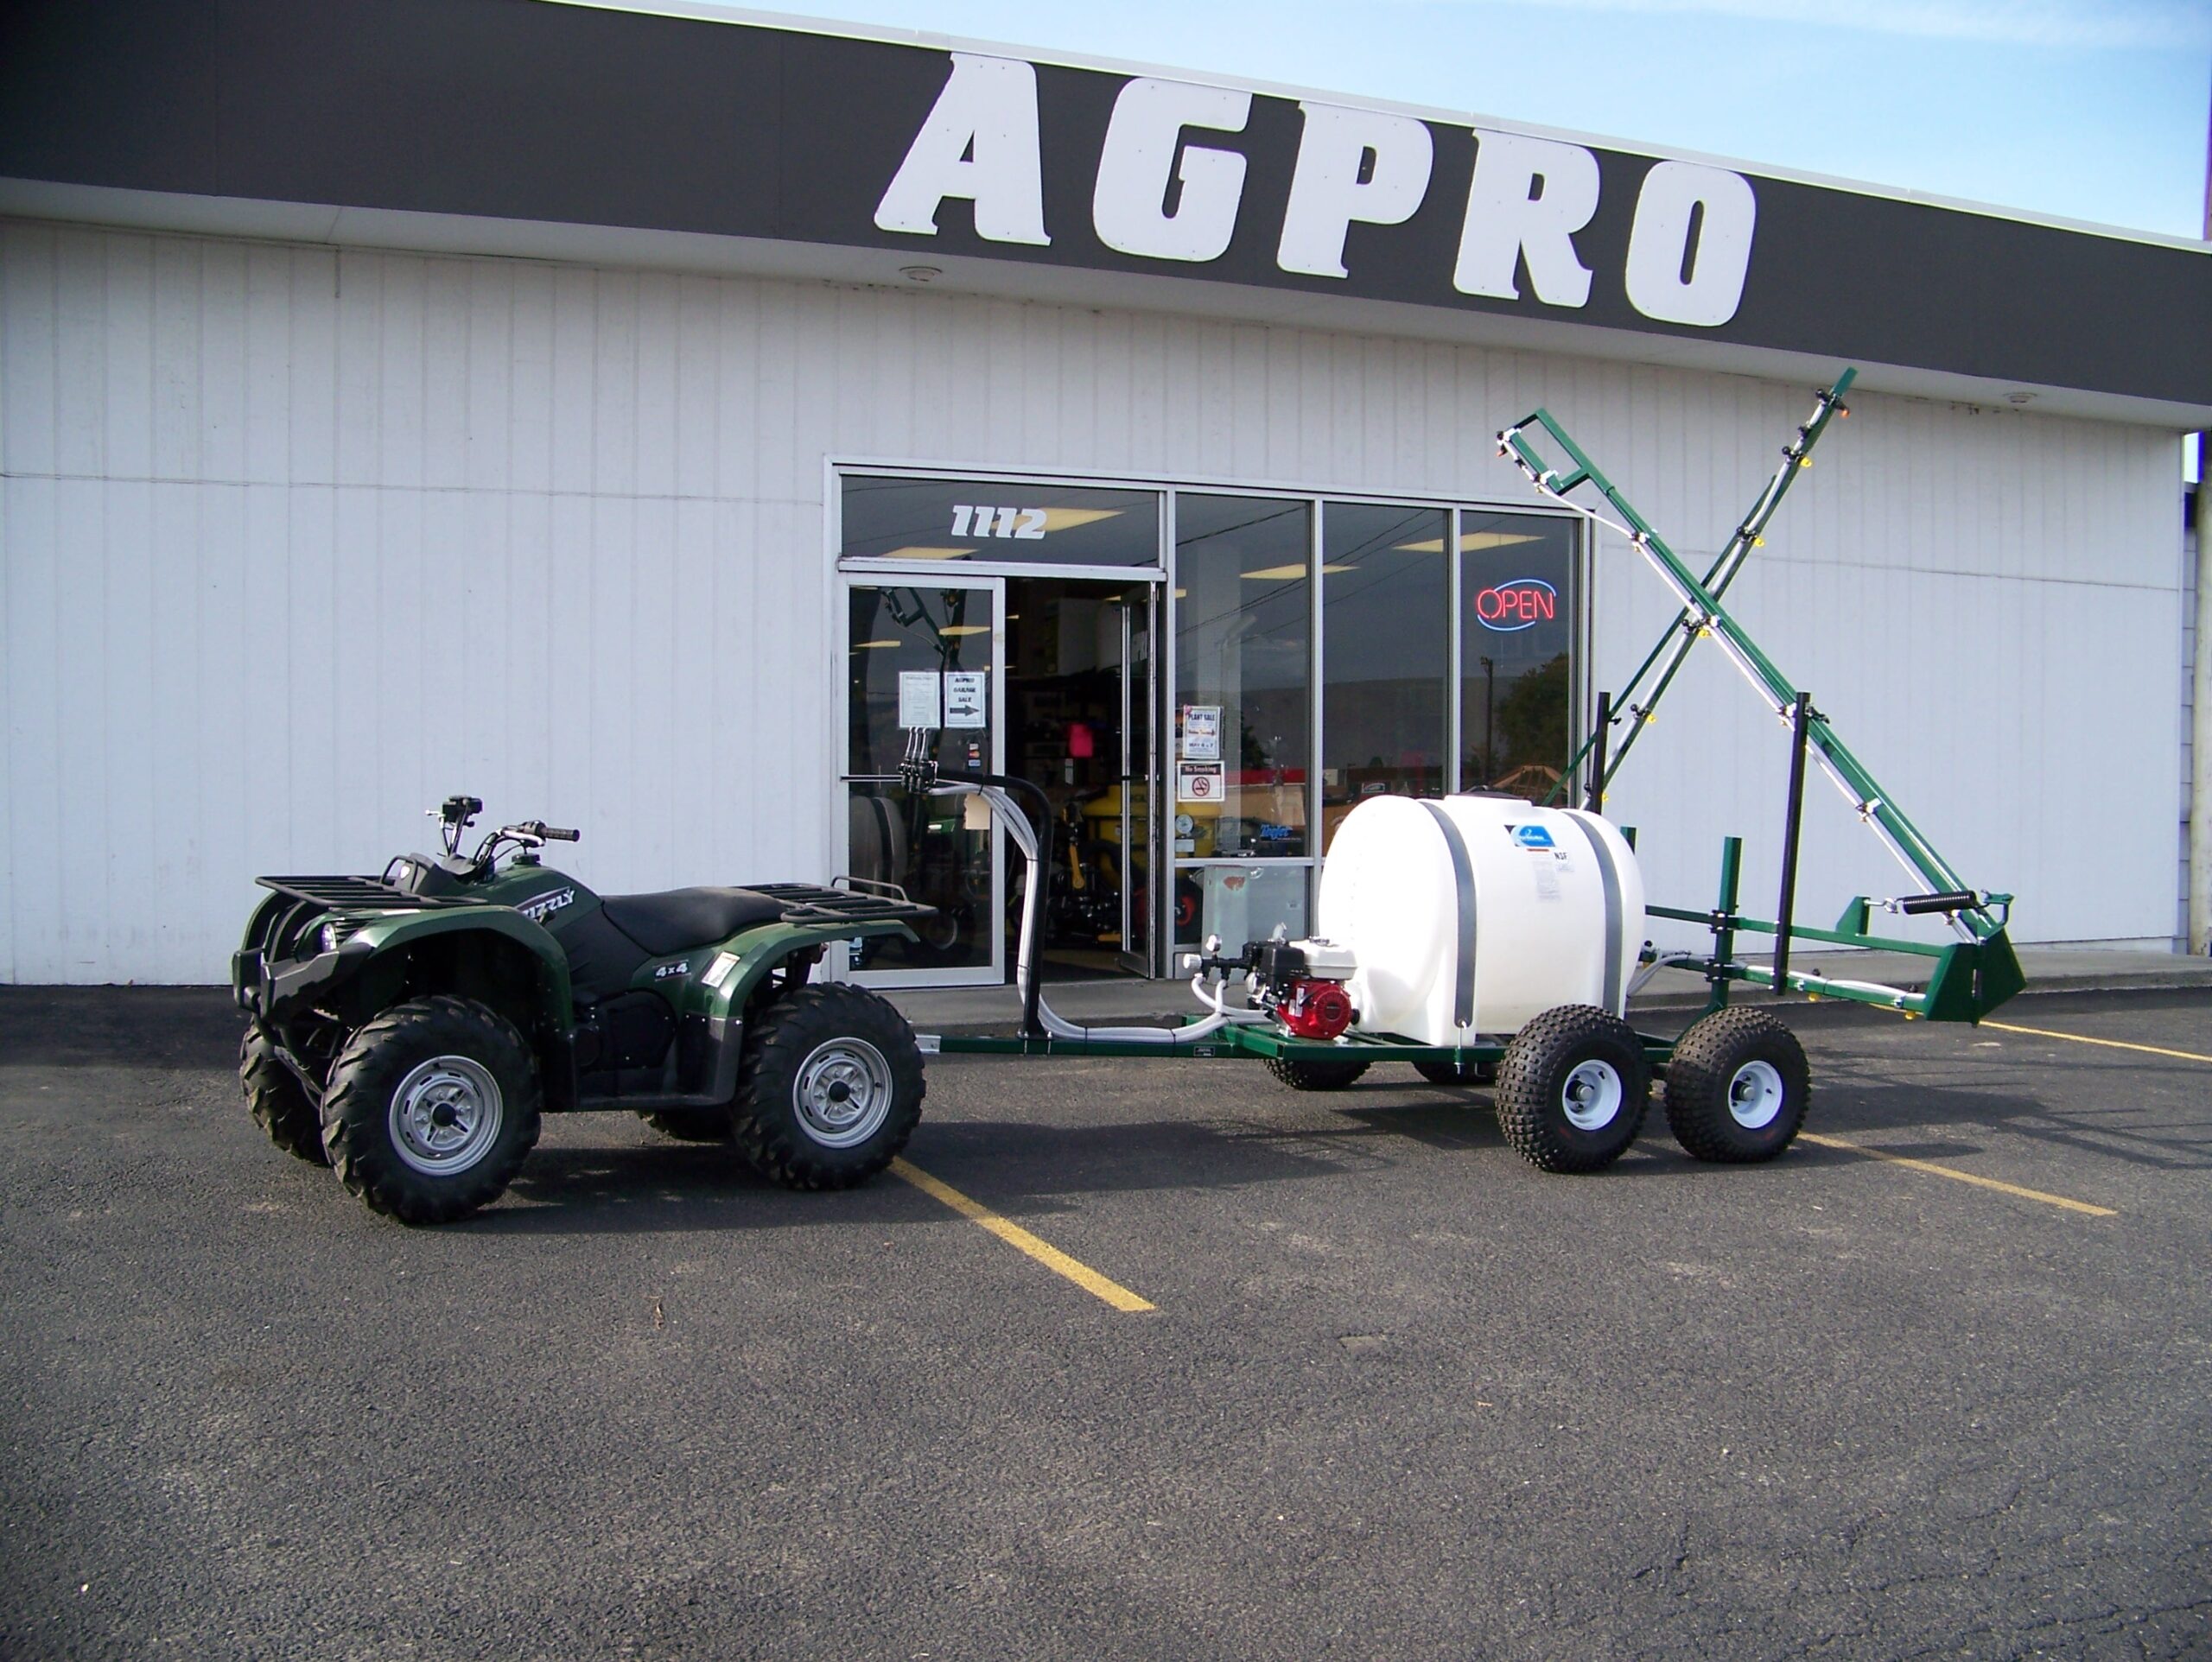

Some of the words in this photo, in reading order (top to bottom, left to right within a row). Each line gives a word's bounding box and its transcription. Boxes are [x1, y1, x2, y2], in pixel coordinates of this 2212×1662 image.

[874, 52, 1758, 327] AGPRO
[950, 504, 1048, 540] 1112
[1477, 589, 1554, 619] OPEN
[1194, 764, 1217, 774] Smoking
